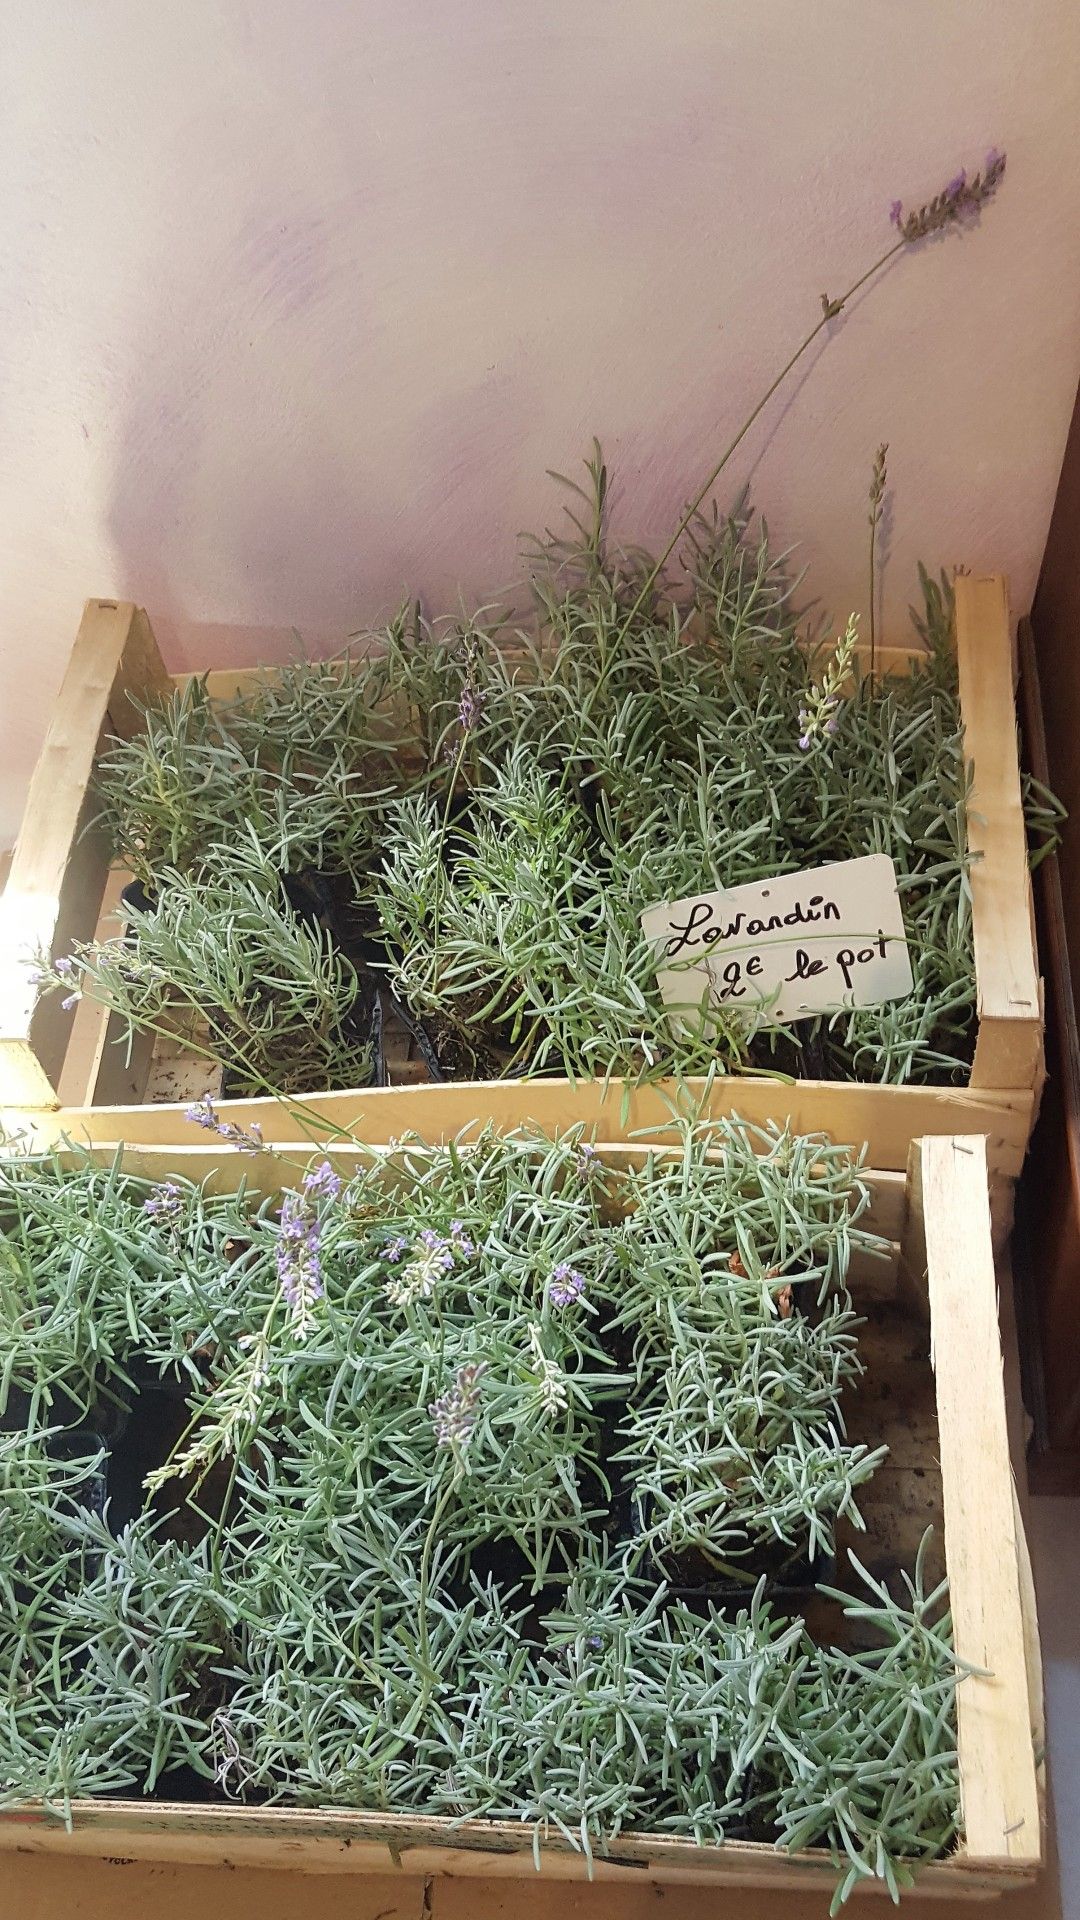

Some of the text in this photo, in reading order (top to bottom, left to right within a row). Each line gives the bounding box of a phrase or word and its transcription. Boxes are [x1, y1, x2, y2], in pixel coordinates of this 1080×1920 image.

[666, 897, 840, 957] Lavandin
[785, 949, 828, 981] le
[836, 929, 890, 988] pot
